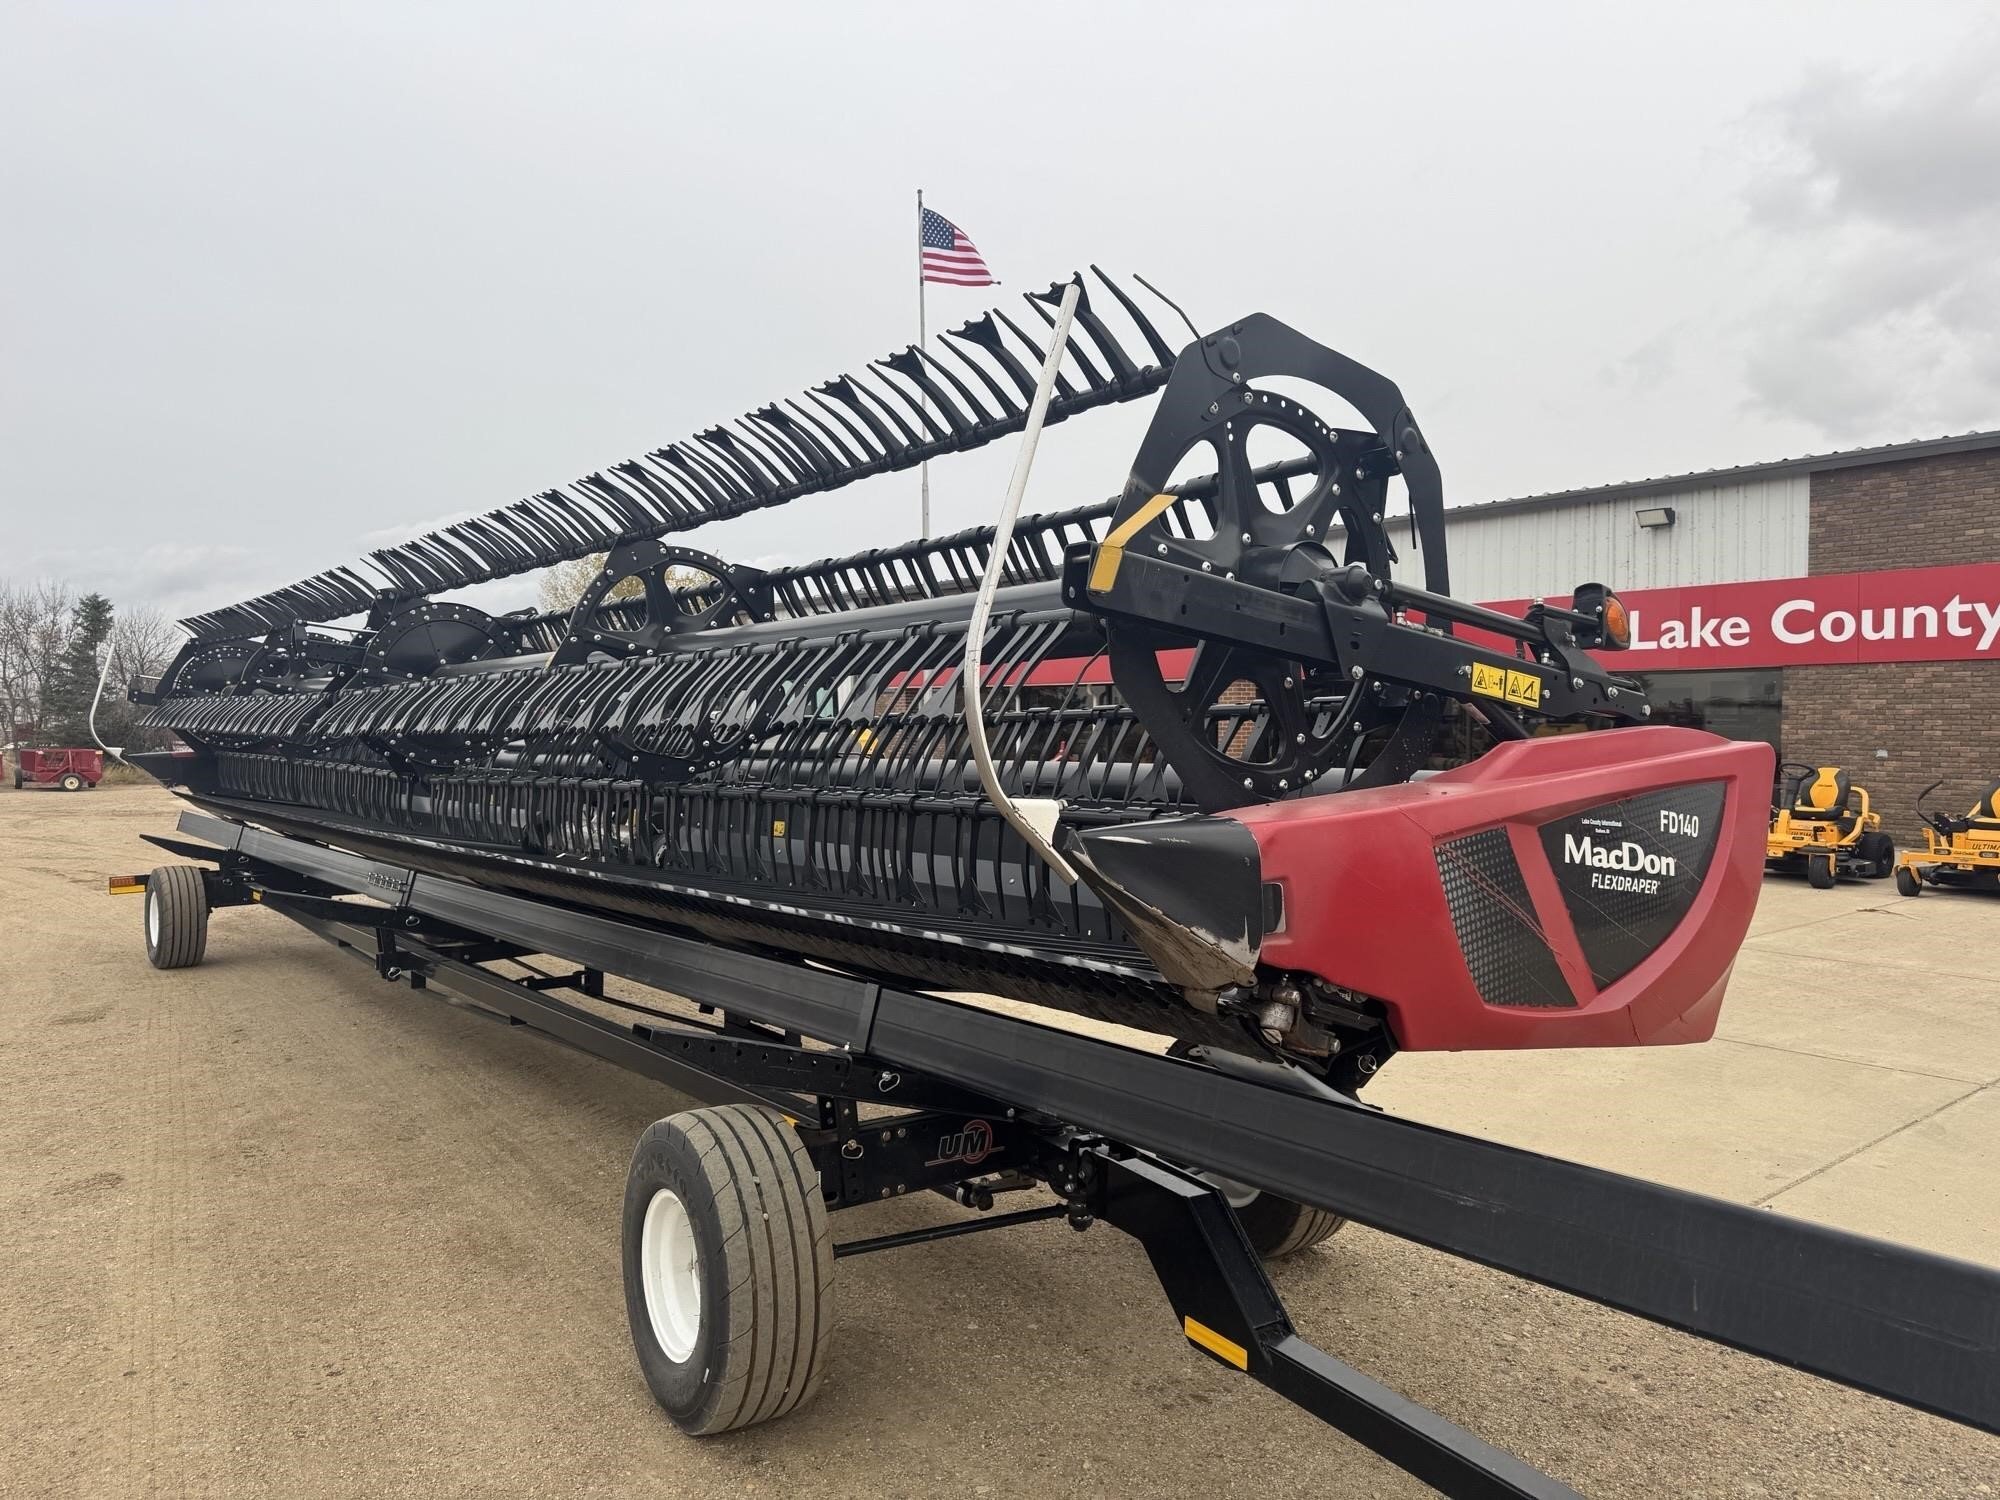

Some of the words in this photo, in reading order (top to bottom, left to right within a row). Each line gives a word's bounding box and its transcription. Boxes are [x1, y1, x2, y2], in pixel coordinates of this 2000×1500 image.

[1629, 606, 1750, 650] Lake
[1770, 594, 2000, 650] County
[1660, 810, 1699, 838] FD140
[1564, 833, 1676, 877] MacDon
